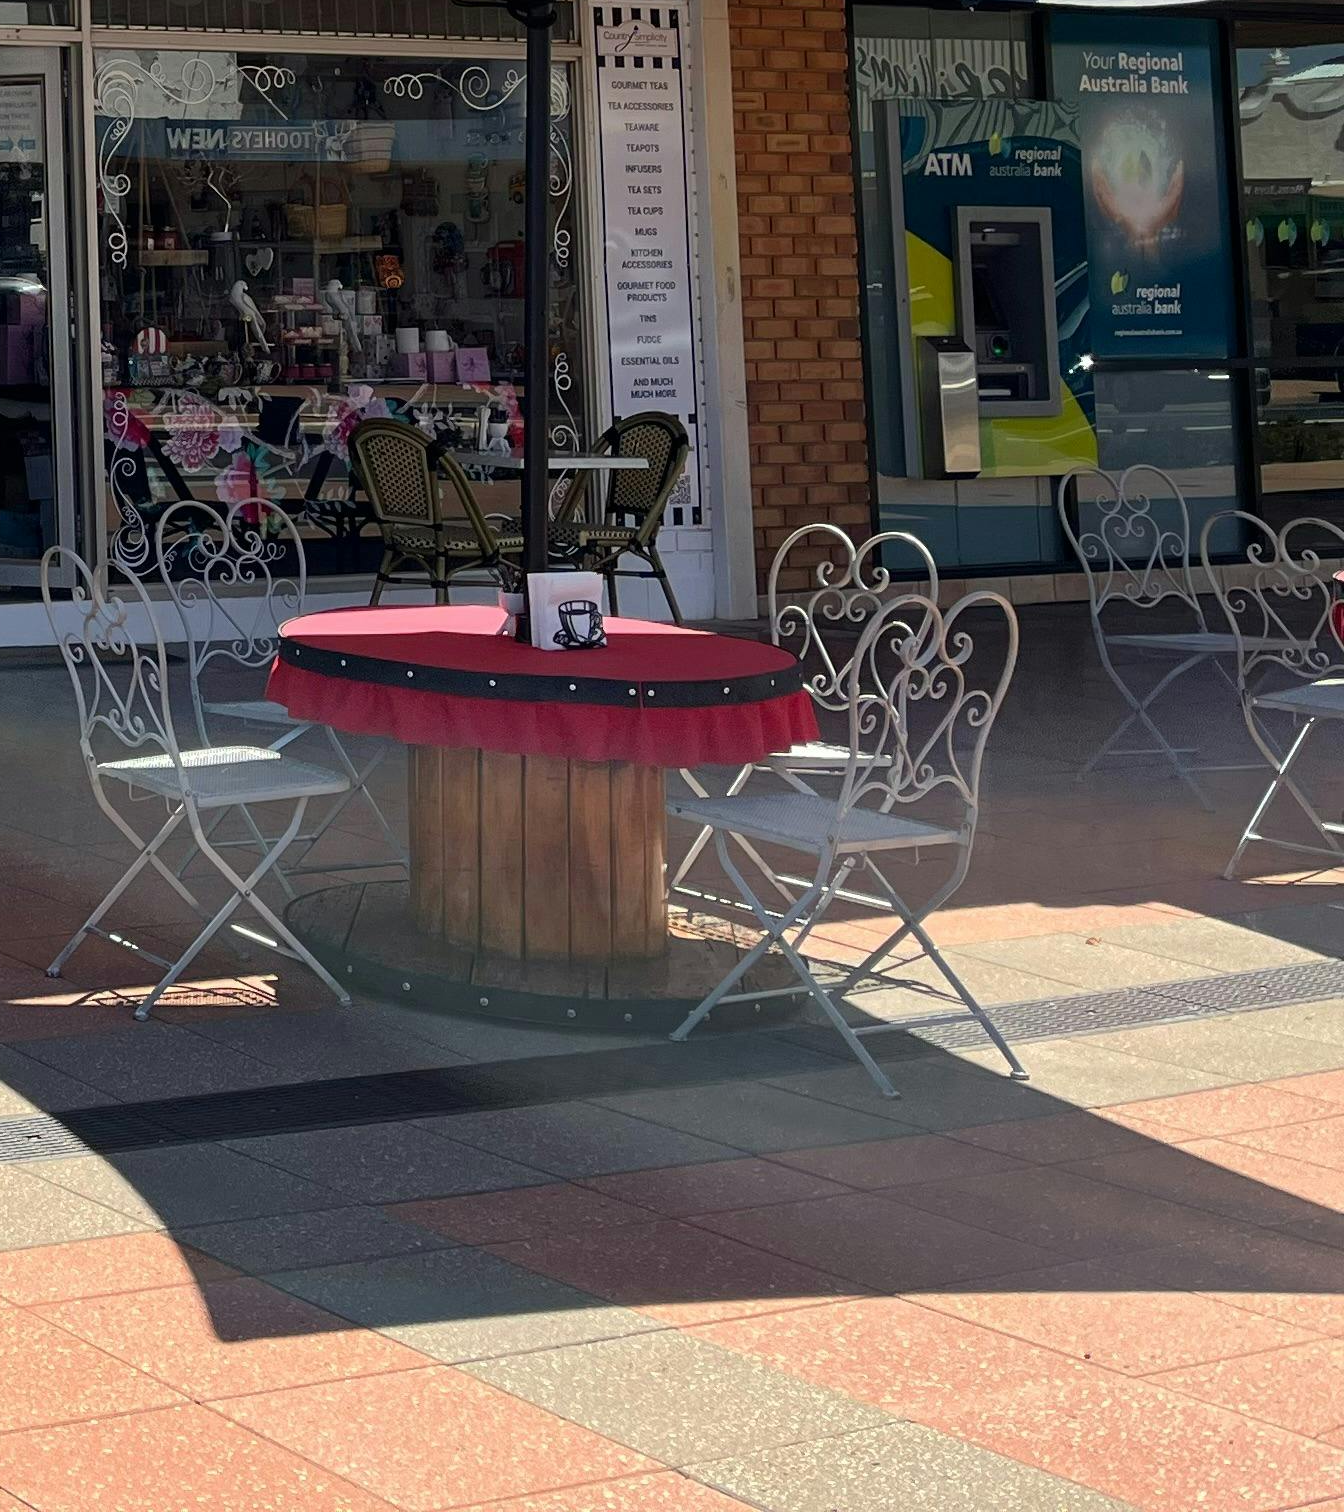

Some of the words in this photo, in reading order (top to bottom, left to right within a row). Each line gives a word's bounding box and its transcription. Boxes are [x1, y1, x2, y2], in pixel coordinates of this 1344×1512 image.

[1082, 51, 1115, 71] Your
[1118, 50, 1184, 74] Regional
[611, 81, 648, 90] GOURMET
[1079, 74, 1148, 93] Australia
[1150, 75, 1189, 94] Bank
[608, 101, 622, 110] TEA
[623, 102, 674, 111] ACCESSORIES
[624, 123, 660, 132] TEAWARE
[626, 143, 660, 153] TEAPOTS
[1014, 146, 1063, 163] regional
[625, 165, 662, 174] INFUSERS
[924, 153, 973, 177] ATM
[989, 163, 1031, 177] australia
[1033, 162, 1063, 177] bank
[627, 186, 642, 194] TEA
[643, 186, 662, 195] SETS
[627, 207, 642, 215] TEA
[643, 207, 664, 216] CUPS
[634, 228, 658, 237] MUGS
[630, 249, 663, 257] KITCHEN
[622, 261, 673, 269] ACCESSORIES
[1136, 283, 1181, 301] regional
[627, 293, 667, 302] PRODUCTS
[1111, 300, 1152, 316] australia
[1154, 300, 1183, 316] bank
[639, 314, 657, 323] TINS
[621, 356, 661, 365] ESSENTIAL
[633, 378, 650, 386] AND
[651, 377, 674, 386] MUCH
[630, 390, 653, 399] MUCH
[654, 389, 677, 398] MORE
